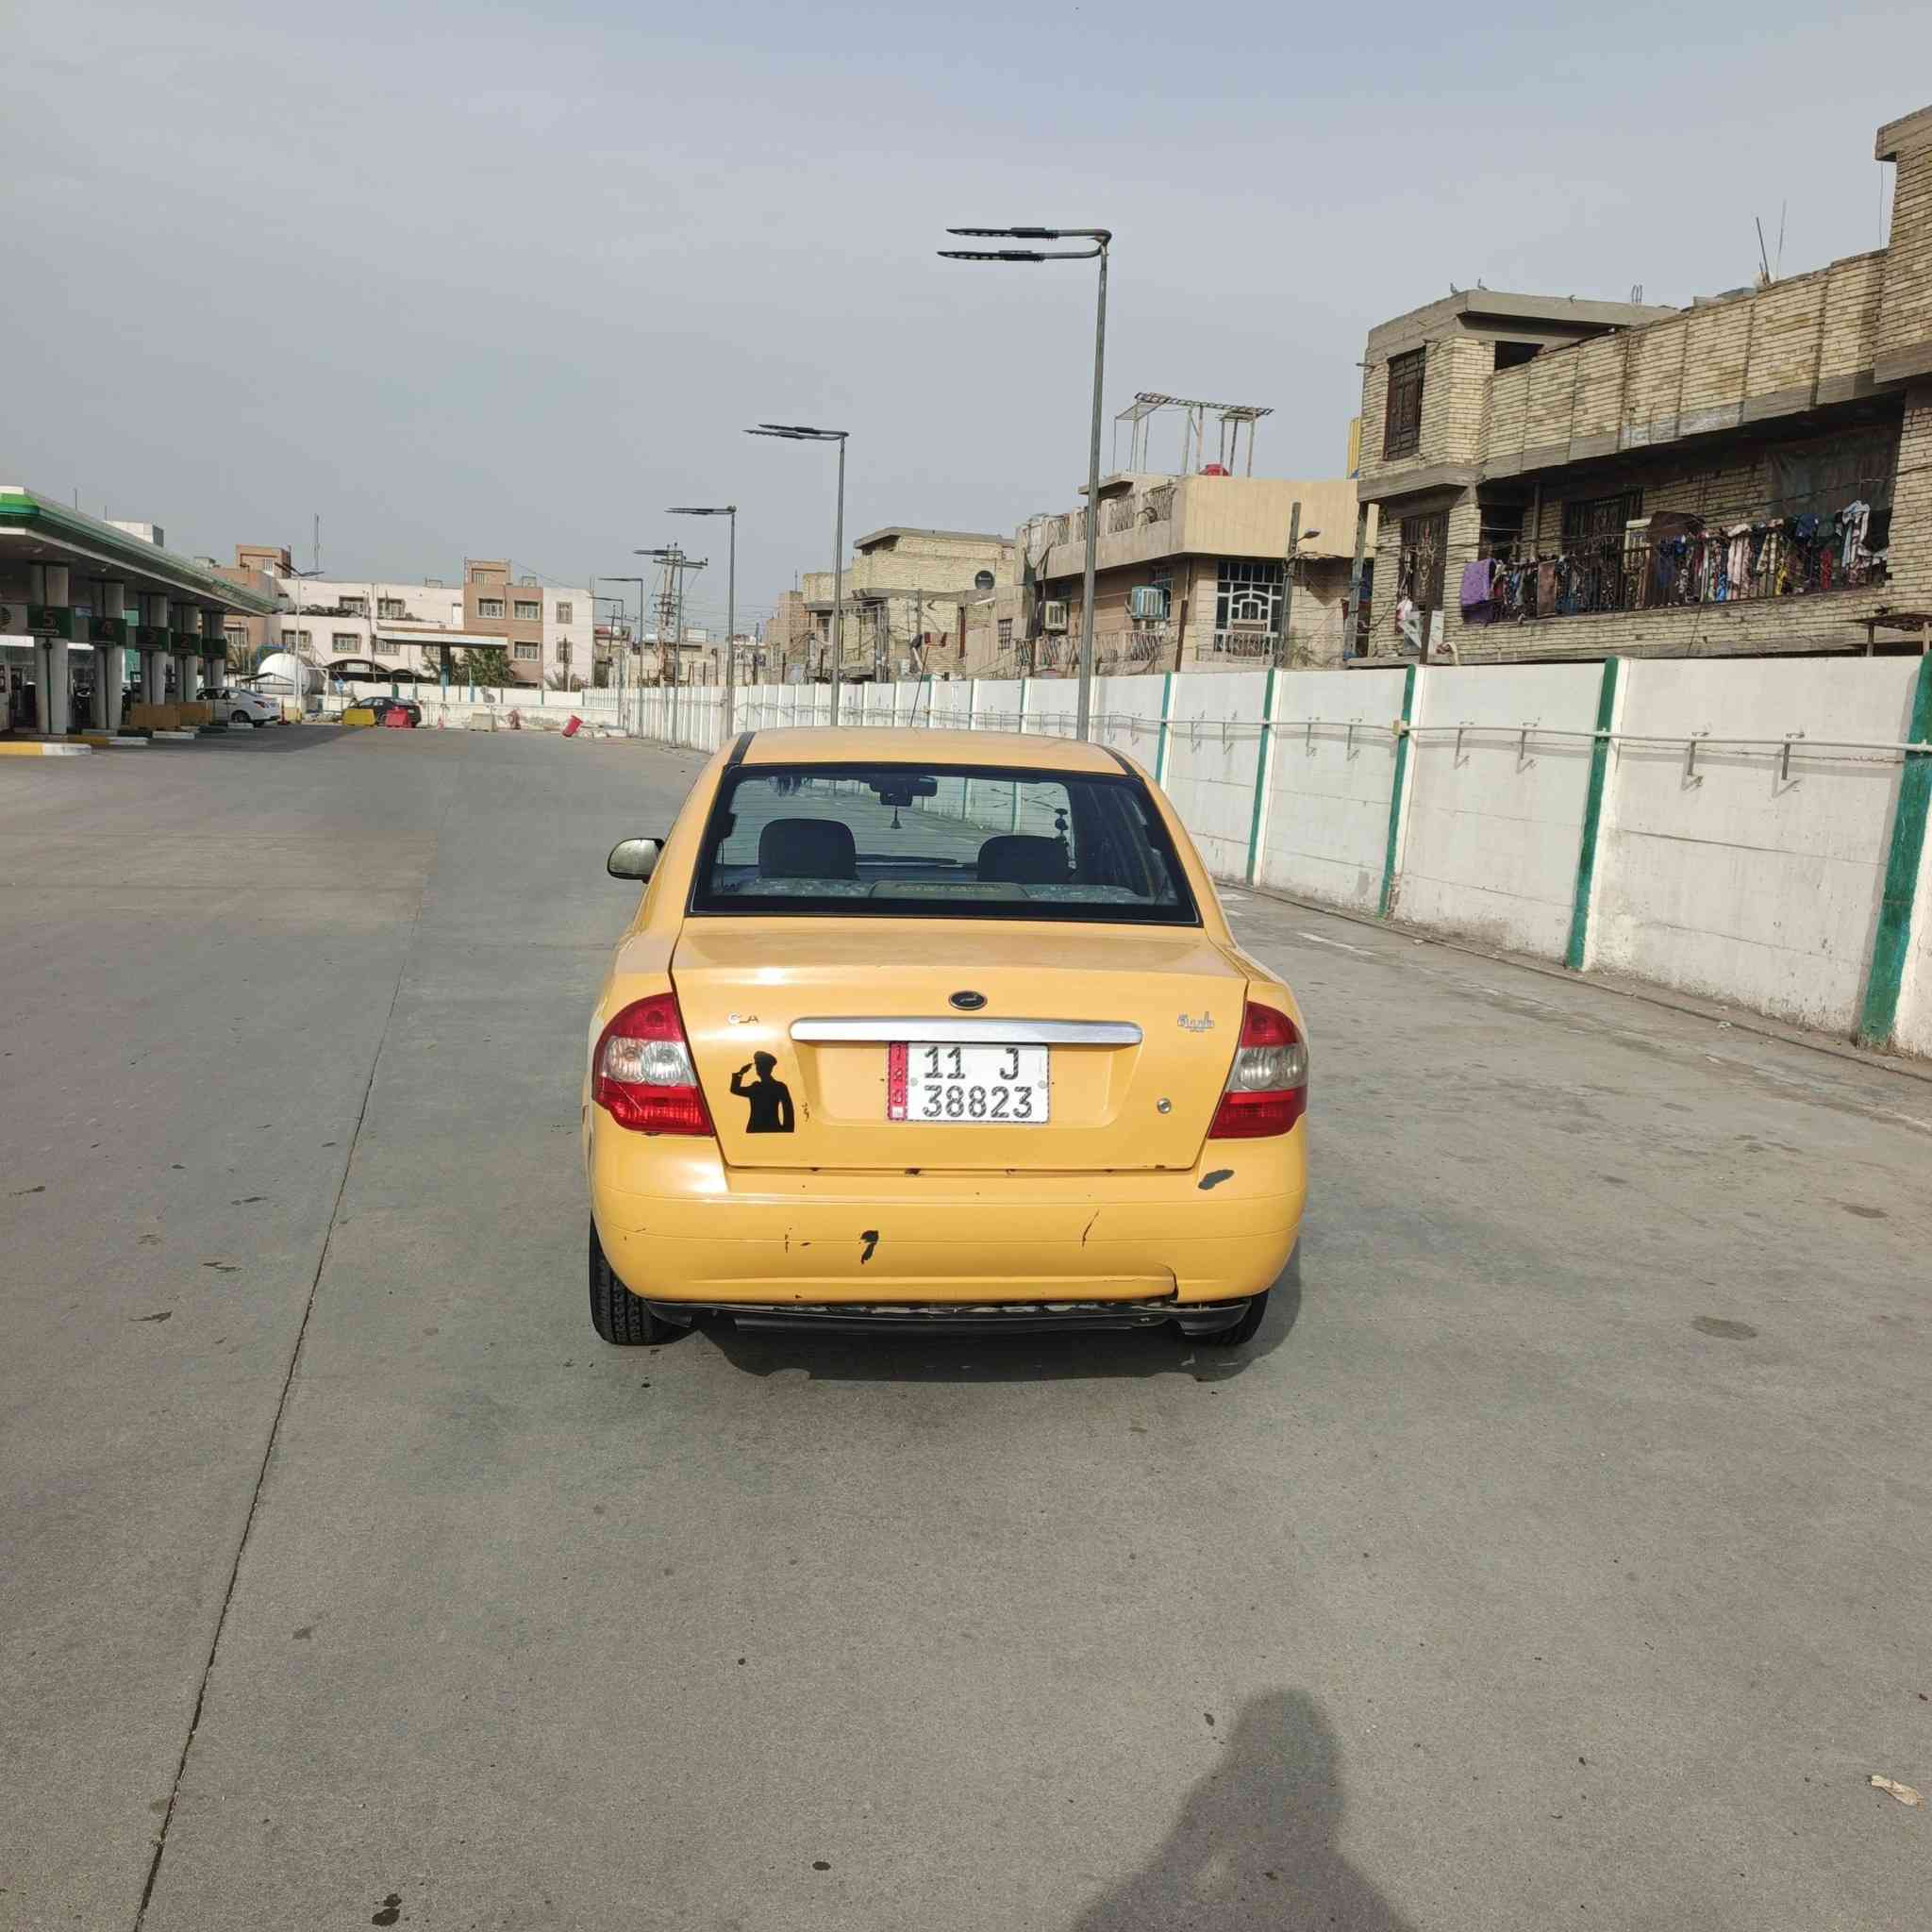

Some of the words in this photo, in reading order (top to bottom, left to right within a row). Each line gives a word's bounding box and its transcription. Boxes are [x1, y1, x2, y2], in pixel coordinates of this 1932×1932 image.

[924, 1046, 966, 1079] 11
[999, 1047, 1019, 1080] J
[923, 1085, 1032, 1119] 38823
